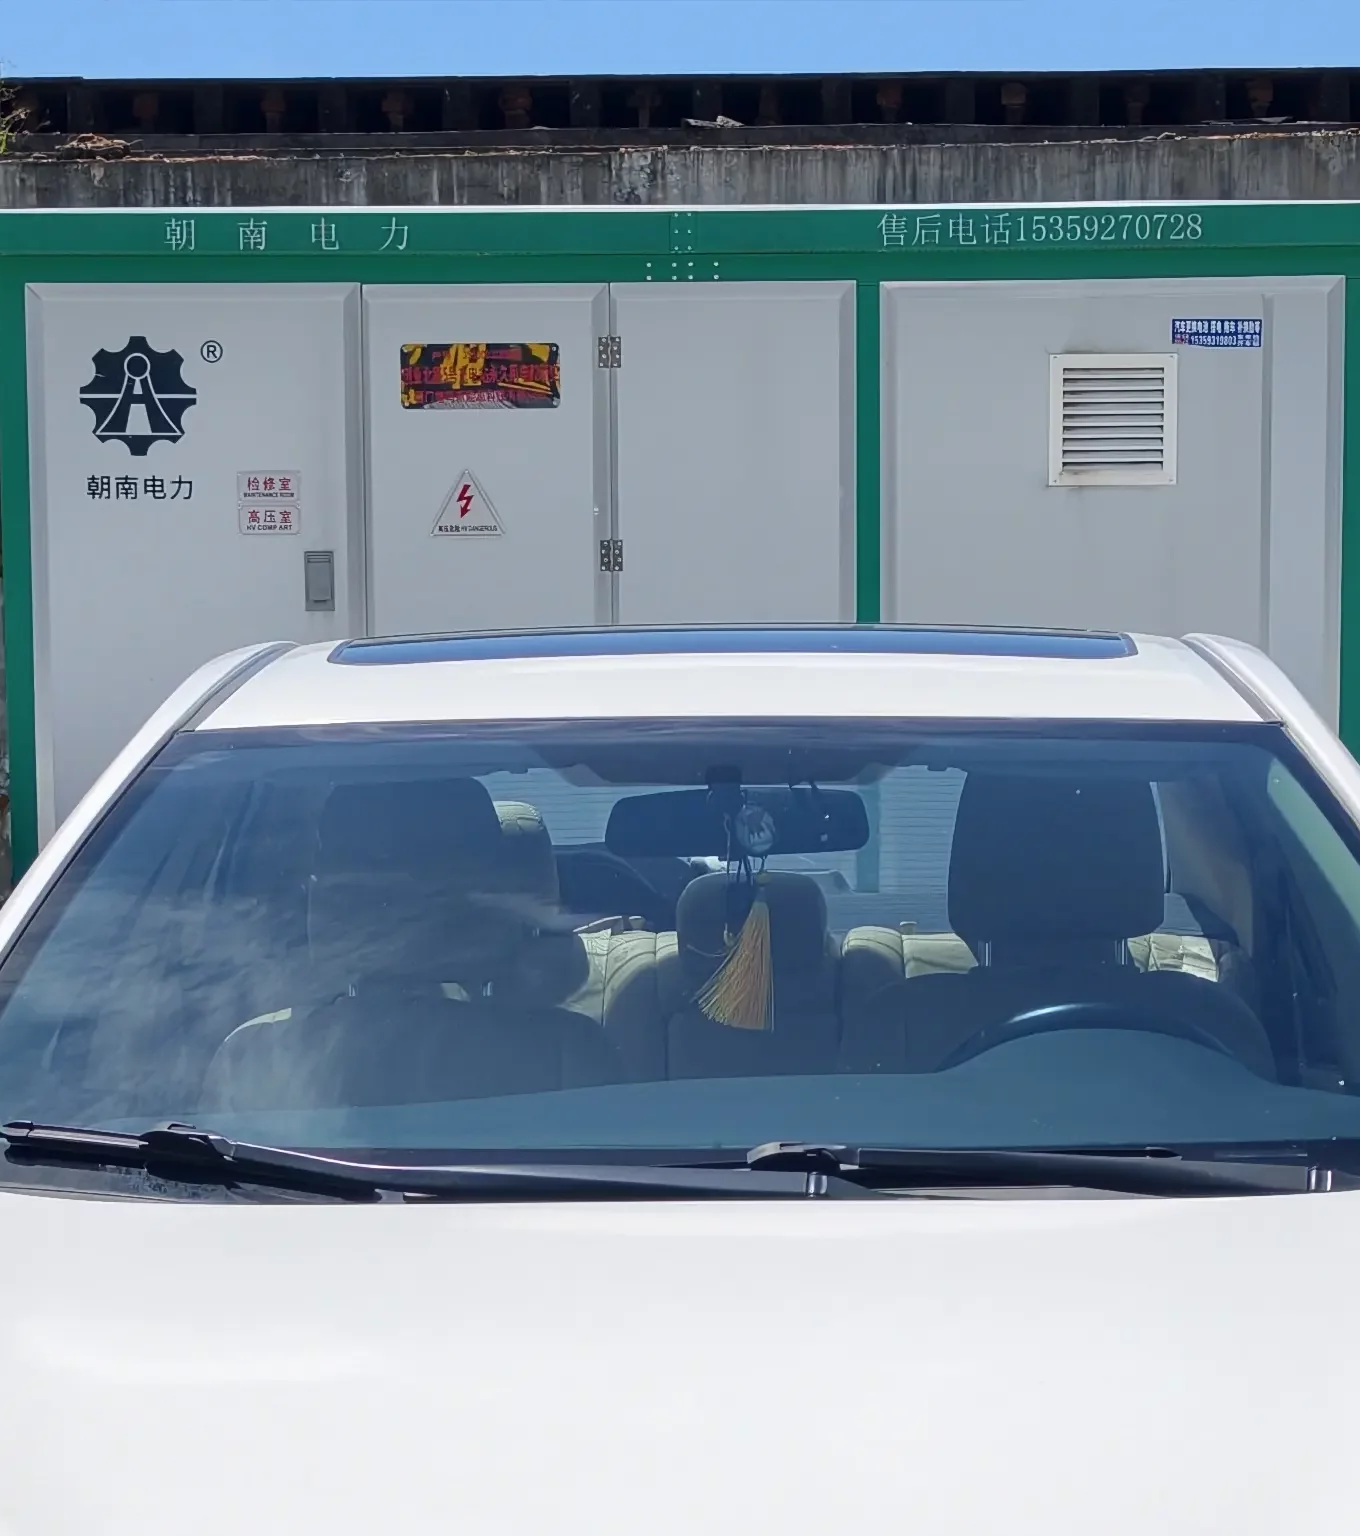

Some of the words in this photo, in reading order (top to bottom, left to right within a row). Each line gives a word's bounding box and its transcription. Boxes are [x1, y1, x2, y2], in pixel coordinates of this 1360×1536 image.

[877, 212, 1202, 247] 售后电话15359270728
[87, 475, 193, 500] 朝南电力
[247, 476, 292, 491] 检修室
[248, 509, 292, 524] 高压室
